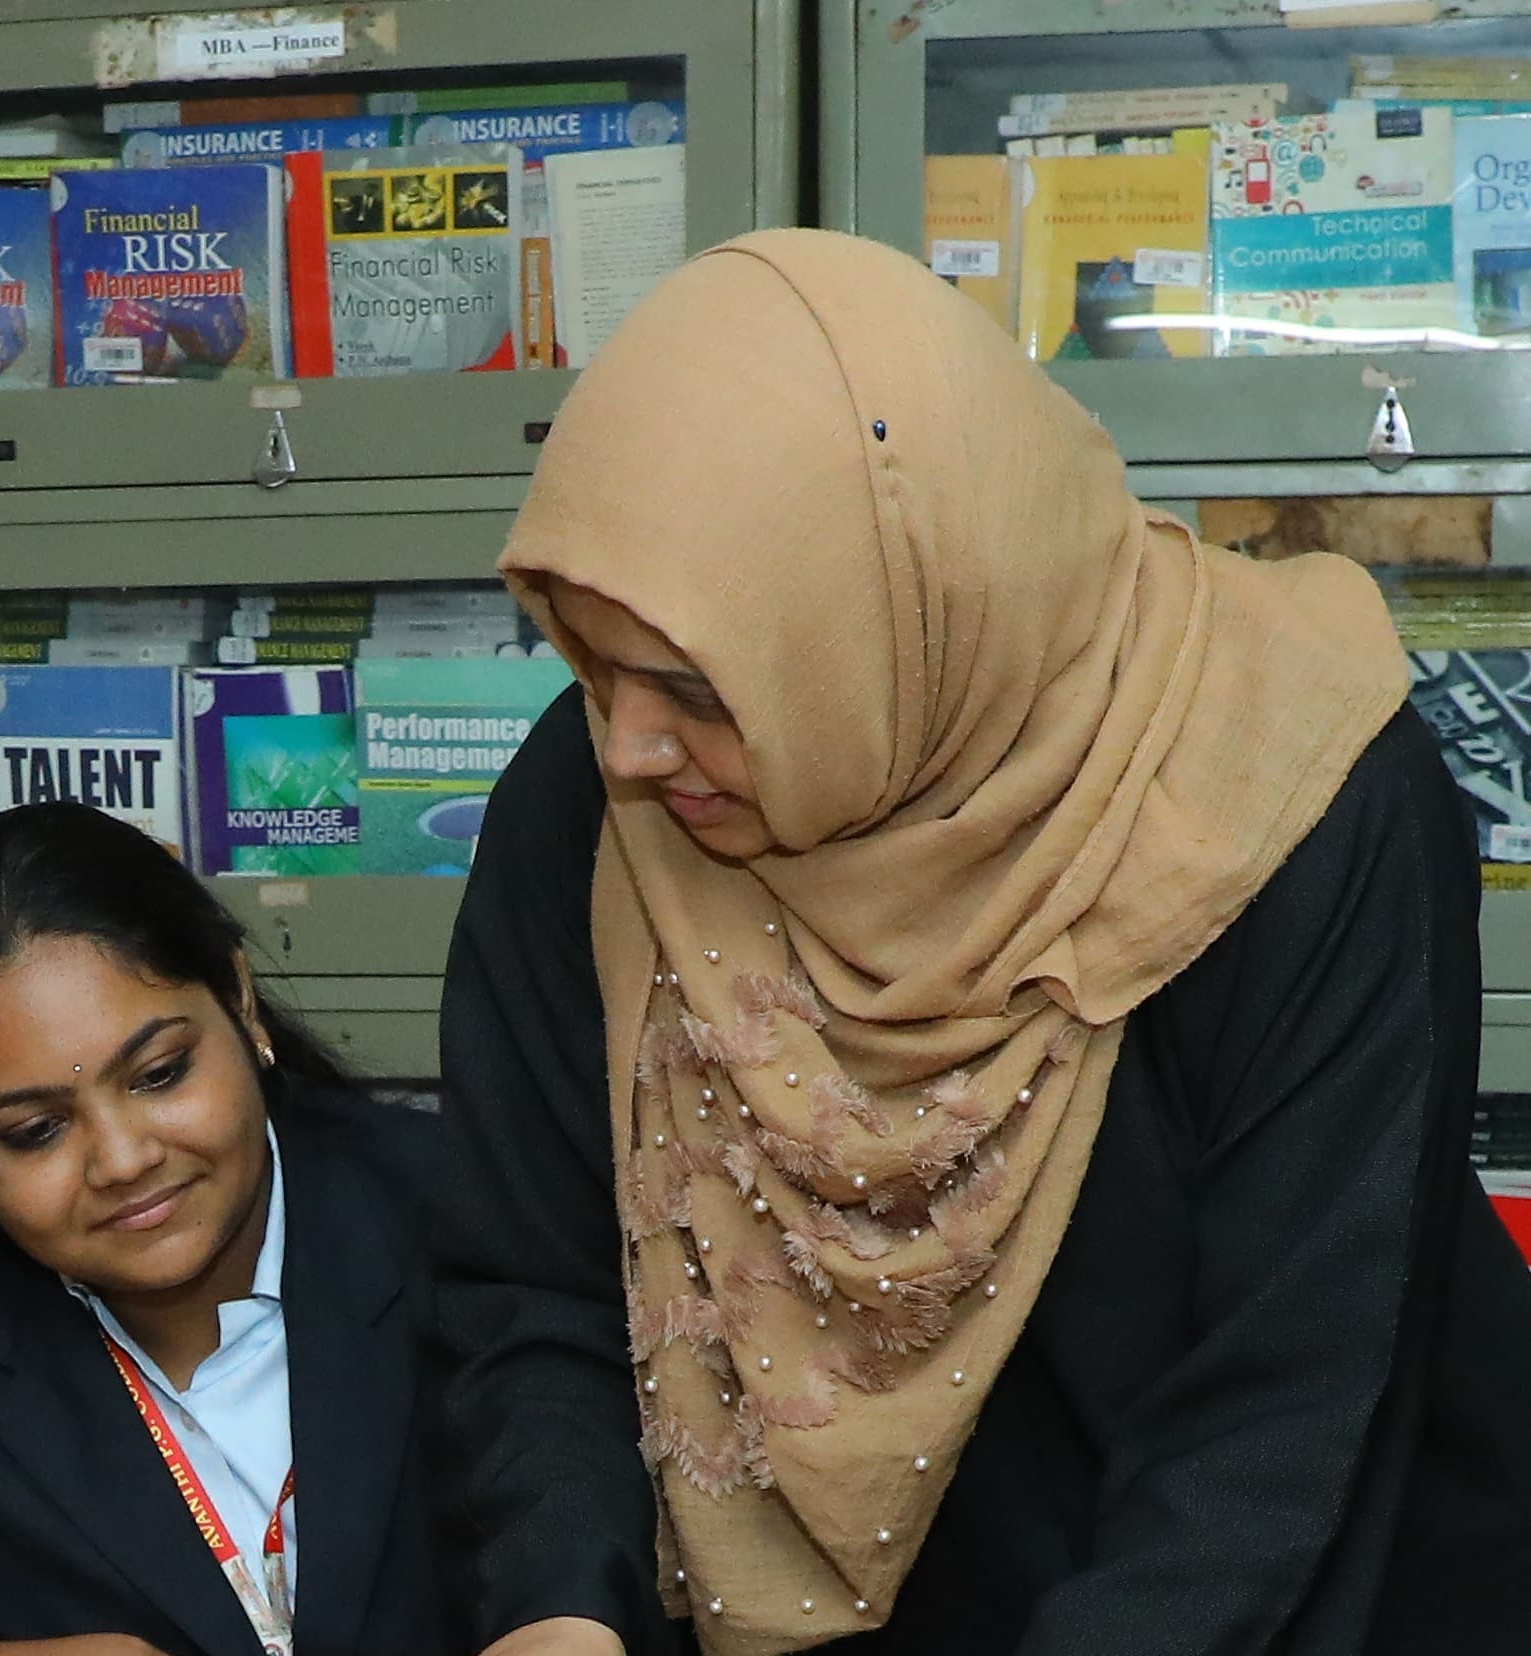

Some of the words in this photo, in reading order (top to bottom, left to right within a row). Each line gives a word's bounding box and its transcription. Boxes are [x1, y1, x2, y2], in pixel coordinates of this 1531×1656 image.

[203, 39, 245, 55] MBA
[456, 114, 582, 143] INSURANCE
[160, 130, 283, 157] INSURANCE
[84, 205, 199, 235] Financial
[1311, 210, 1428, 237] Technical
[123, 232, 232, 273] RISK
[331, 248, 439, 280] Financial
[452, 246, 498, 274] Risk
[1228, 238, 1428, 268] Communication
[84, 268, 243, 301] Management
[332, 293, 496, 325] Management
[366, 712, 531, 741] Performance
[4, 747, 161, 808] TALENT
[227, 808, 343, 829] KNOWLEDGE
[267, 826, 358, 844] MANAGEME
